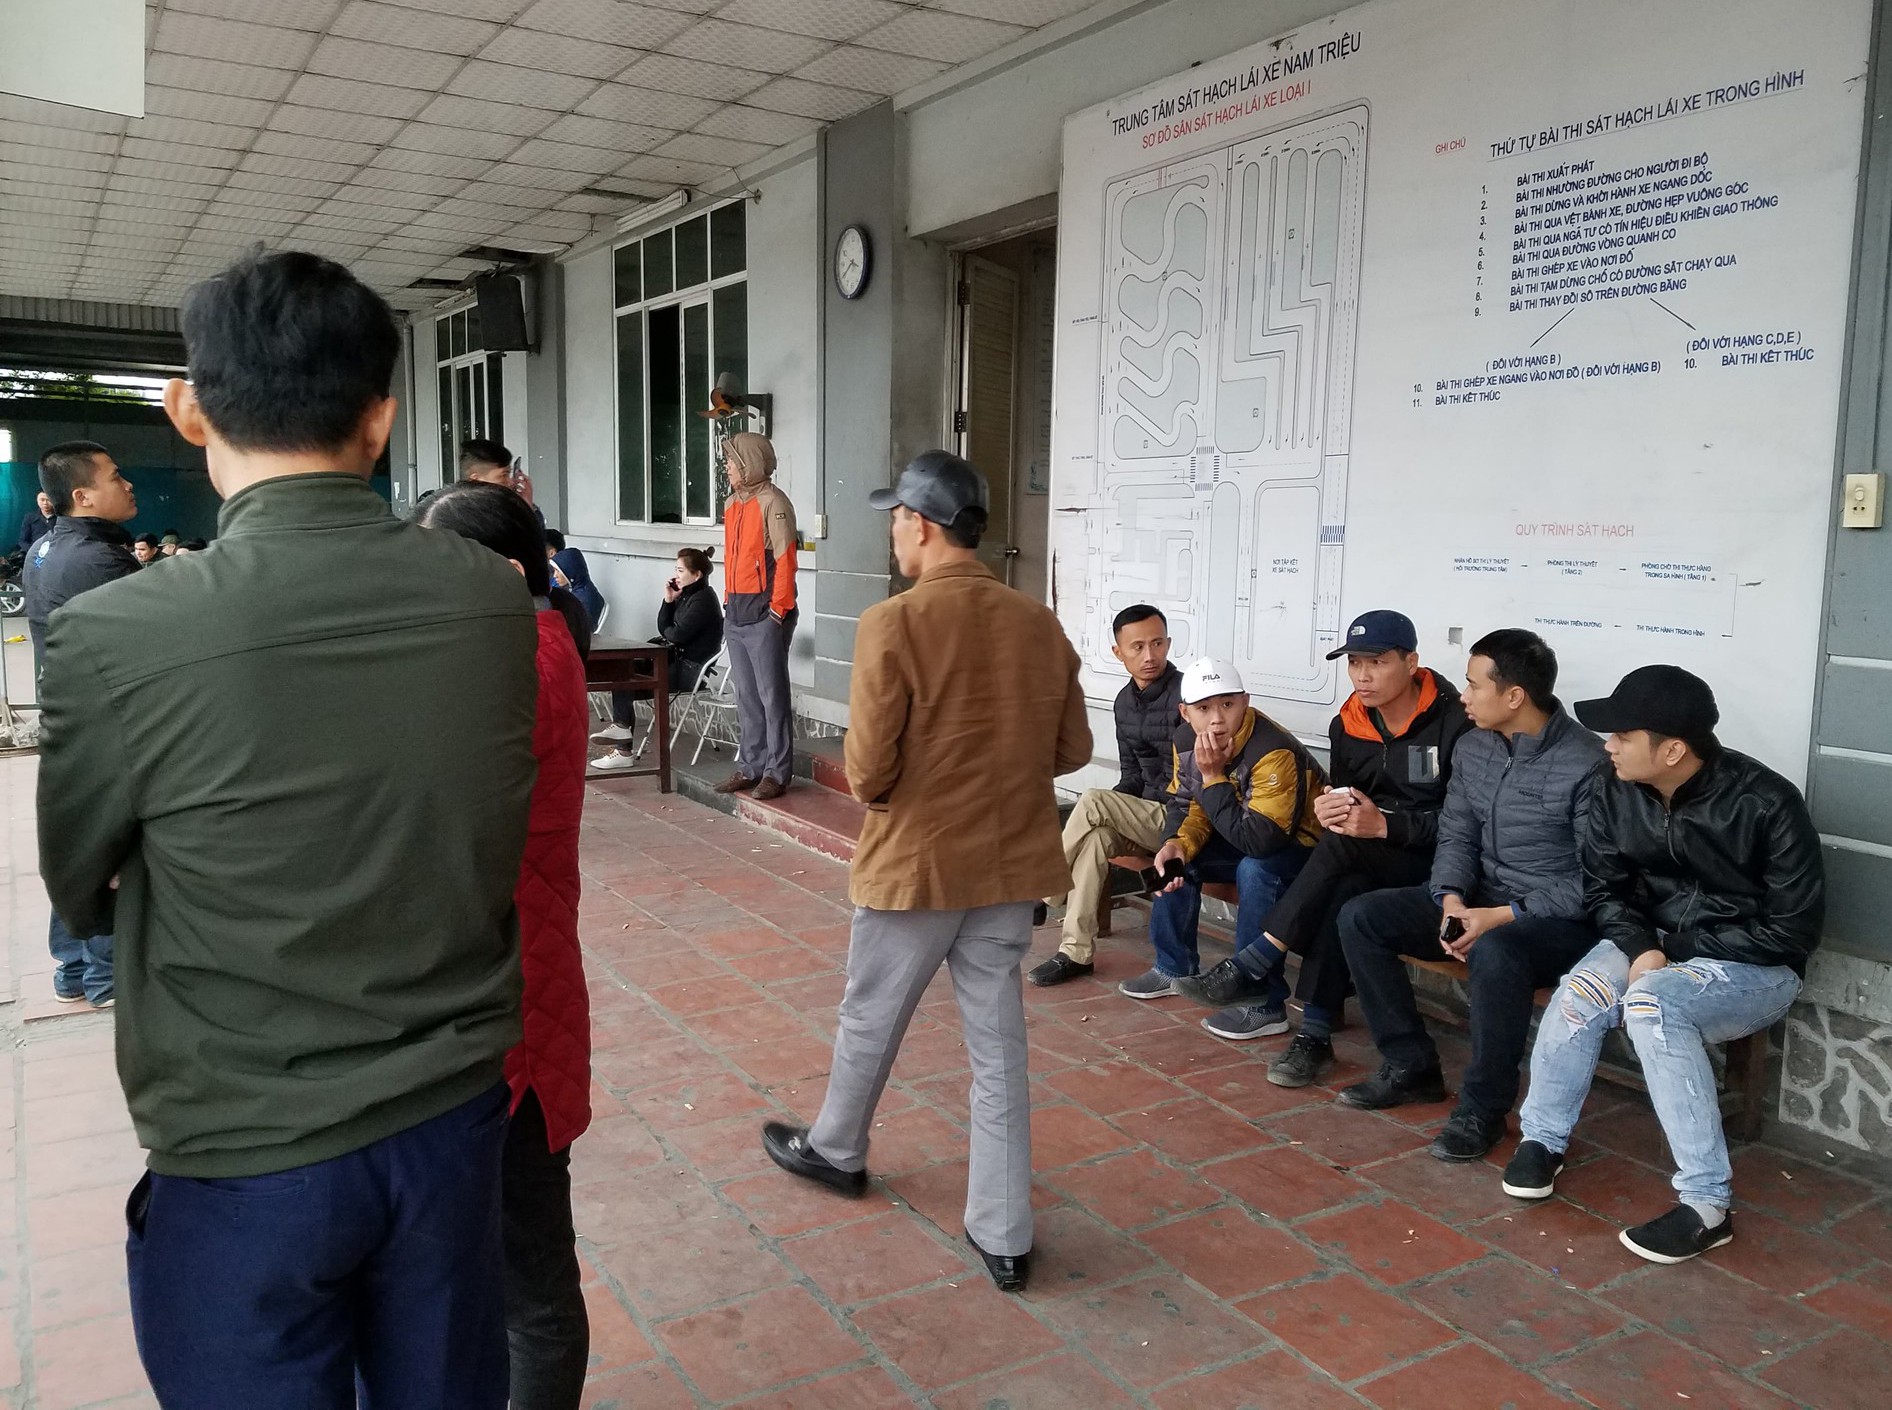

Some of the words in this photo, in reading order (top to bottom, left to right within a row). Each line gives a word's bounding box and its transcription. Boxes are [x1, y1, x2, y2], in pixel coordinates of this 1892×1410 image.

[1113, 108, 1148, 136] TRUNG
[1152, 98, 1175, 122] TÂM
[1178, 88, 1200, 113] SÁT
[1203, 76, 1236, 104] HẠCH
[1240, 65, 1259, 92] LÁI
[1262, 60, 1281, 84] XE
[1284, 48, 1313, 76] NAM
[1318, 31, 1361, 64] TRIỆU
[1194, 112, 1213, 131] SÁT
[1215, 102, 1242, 125] HẠCH
[1246, 94, 1260, 115] LÁI
[1263, 91, 1277, 109] XE
[1280, 81, 1305, 104] LOẠI
[1539, 126, 1558, 146] BÀI
[1562, 123, 1582, 140] THI
[1586, 114, 1612, 134] SÁT
[1615, 105, 1653, 128] HẠCH
[1657, 97, 1678, 119] LÁI
[1682, 93, 1701, 113] XE
[1706, 80, 1760, 106] TRONG
[1765, 69, 1805, 93] HÌNH
[1435, 144, 1448, 154] GHI
[1516, 189, 1529, 203] BÀI
[1531, 188, 1544, 200] THI
[1623, 167, 1645, 181] CHO
[1682, 158, 1691, 170] ĐI
[1517, 173, 1530, 186] BÀI
[1532, 171, 1545, 183] THI
[1571, 159, 1595, 175] PHÁT
[1514, 221, 1527, 234] BÀI
[1529, 220, 1543, 232] THI
[1544, 217, 1562, 230] QUA
[1582, 208, 1607, 222] BÁNH
[1609, 206, 1624, 218] XE,
[1664, 195, 1684, 210] HẸP
[1687, 188, 1723, 204] VUÔNG
[1725, 182, 1749, 197] GÓC
[1515, 205, 1528, 218] BÀI
[1530, 204, 1543, 215] THI
[1573, 193, 1584, 207] VÀ
[1611, 186, 1636, 200] HÀNH
[1638, 183, 1651, 195] XE
[1653, 176, 1688, 192] NGANG
[1513, 237, 1526, 250] BÀI
[1528, 236, 1541, 248] THI
[1543, 233, 1561, 246] QUA
[1599, 222, 1612, 236] CÓ
[1615, 220, 1629, 233] TÍN
[1713, 203, 1738, 217] GIAO
[1740, 196, 1778, 212] THÔNG
[1512, 251, 1525, 264] BÀI
[1527, 251, 1541, 262] THI
[1542, 247, 1560, 260] QUA
[1598, 237, 1624, 251] VÒNG
[1626, 231, 1659, 247] QUANH
[1662, 229, 1676, 240] CO
[1511, 267, 1524, 280] BÀI
[1526, 267, 1540, 278] THI
[1541, 261, 1565, 276] GHÉP
[1566, 261, 1578, 272] XE
[1580, 256, 1599, 270] VÀO
[1511, 283, 1523, 296] BÀI
[1525, 283, 1538, 294] THI
[1540, 280, 1558, 294] TẠM
[1609, 269, 1623, 282] CÓ
[1684, 258, 1713, 273] CHẠY
[1714, 255, 1737, 268] QUA
[1509, 299, 1522, 312] BÀI
[1524, 299, 1537, 310] THI
[1540, 296, 1562, 308] THAY
[1595, 286, 1619, 301] TRÊN
[1733, 335, 1763, 349] HẠNG
[1524, 355, 1548, 368] HẠNG
[1684, 359, 1697, 369] 10.
[1722, 353, 1738, 366] BÀI
[1741, 353, 1757, 365] THI
[1784, 347, 1814, 361] THÚC
[1414, 384, 1423, 393] 10.
[1436, 379, 1448, 390] BÀI
[1450, 380, 1462, 390] THI
[1463, 376, 1485, 388] GHÉP
[1486, 376, 1497, 386] XE
[1499, 372, 1528, 385] NGANG
[1529, 370, 1547, 382] VÀO
[1622, 362, 1649, 376] HẠNG
[1413, 399, 1422, 407] 11.
[1435, 394, 1447, 406] BÀI
[1449, 395, 1460, 405] THI
[1479, 390, 1501, 402] THÚC
[1515, 524, 1539, 536] QUY
[1202, 673, 1220, 681] FILA
